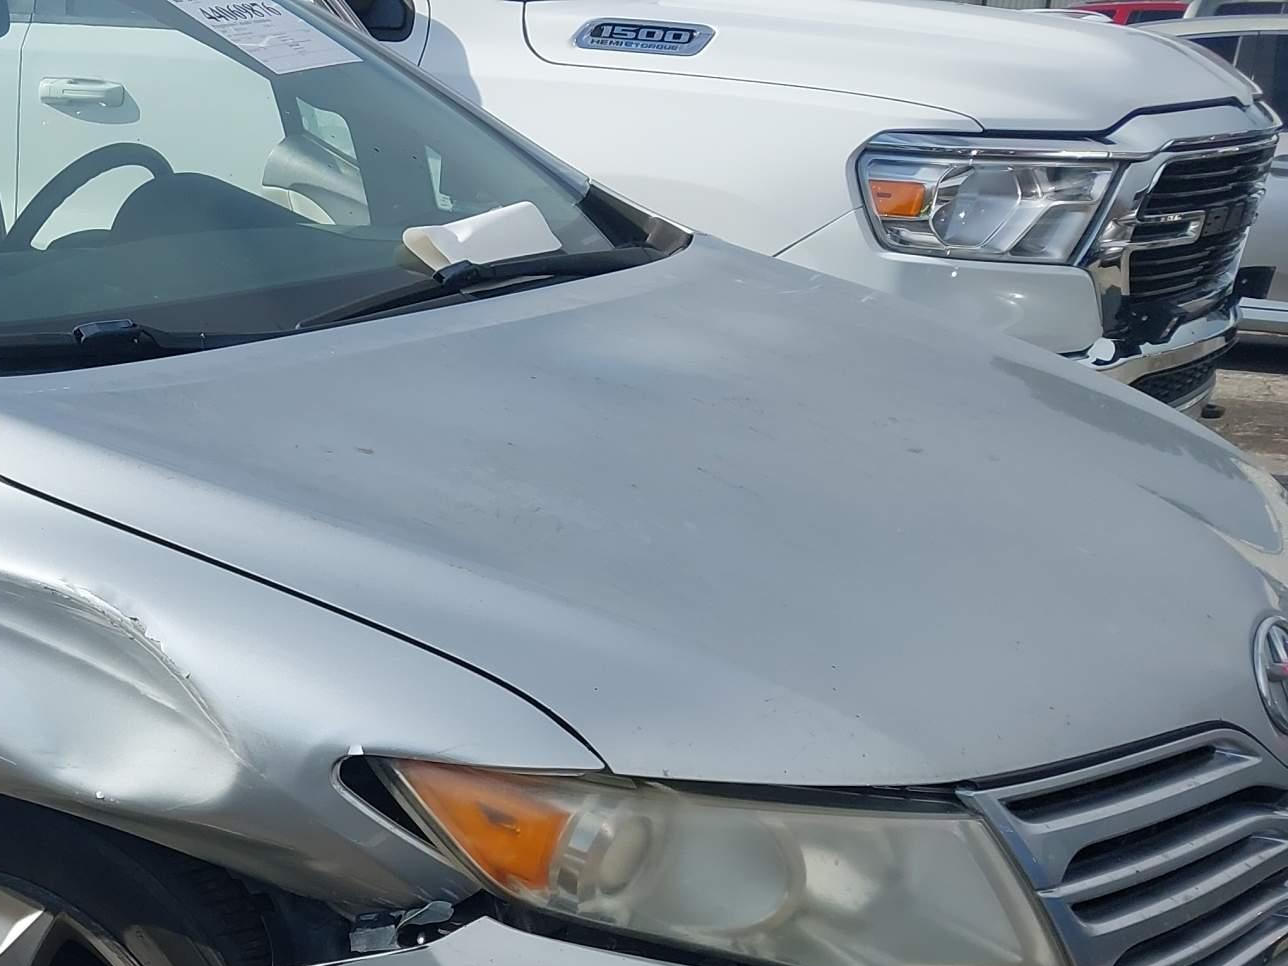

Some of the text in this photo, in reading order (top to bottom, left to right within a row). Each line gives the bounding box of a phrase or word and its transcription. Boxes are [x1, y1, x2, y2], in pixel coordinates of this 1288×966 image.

[199, 2, 281, 22] 44069876
[591, 39, 623, 47] HEMI
[600, 25, 690, 43] 1500
